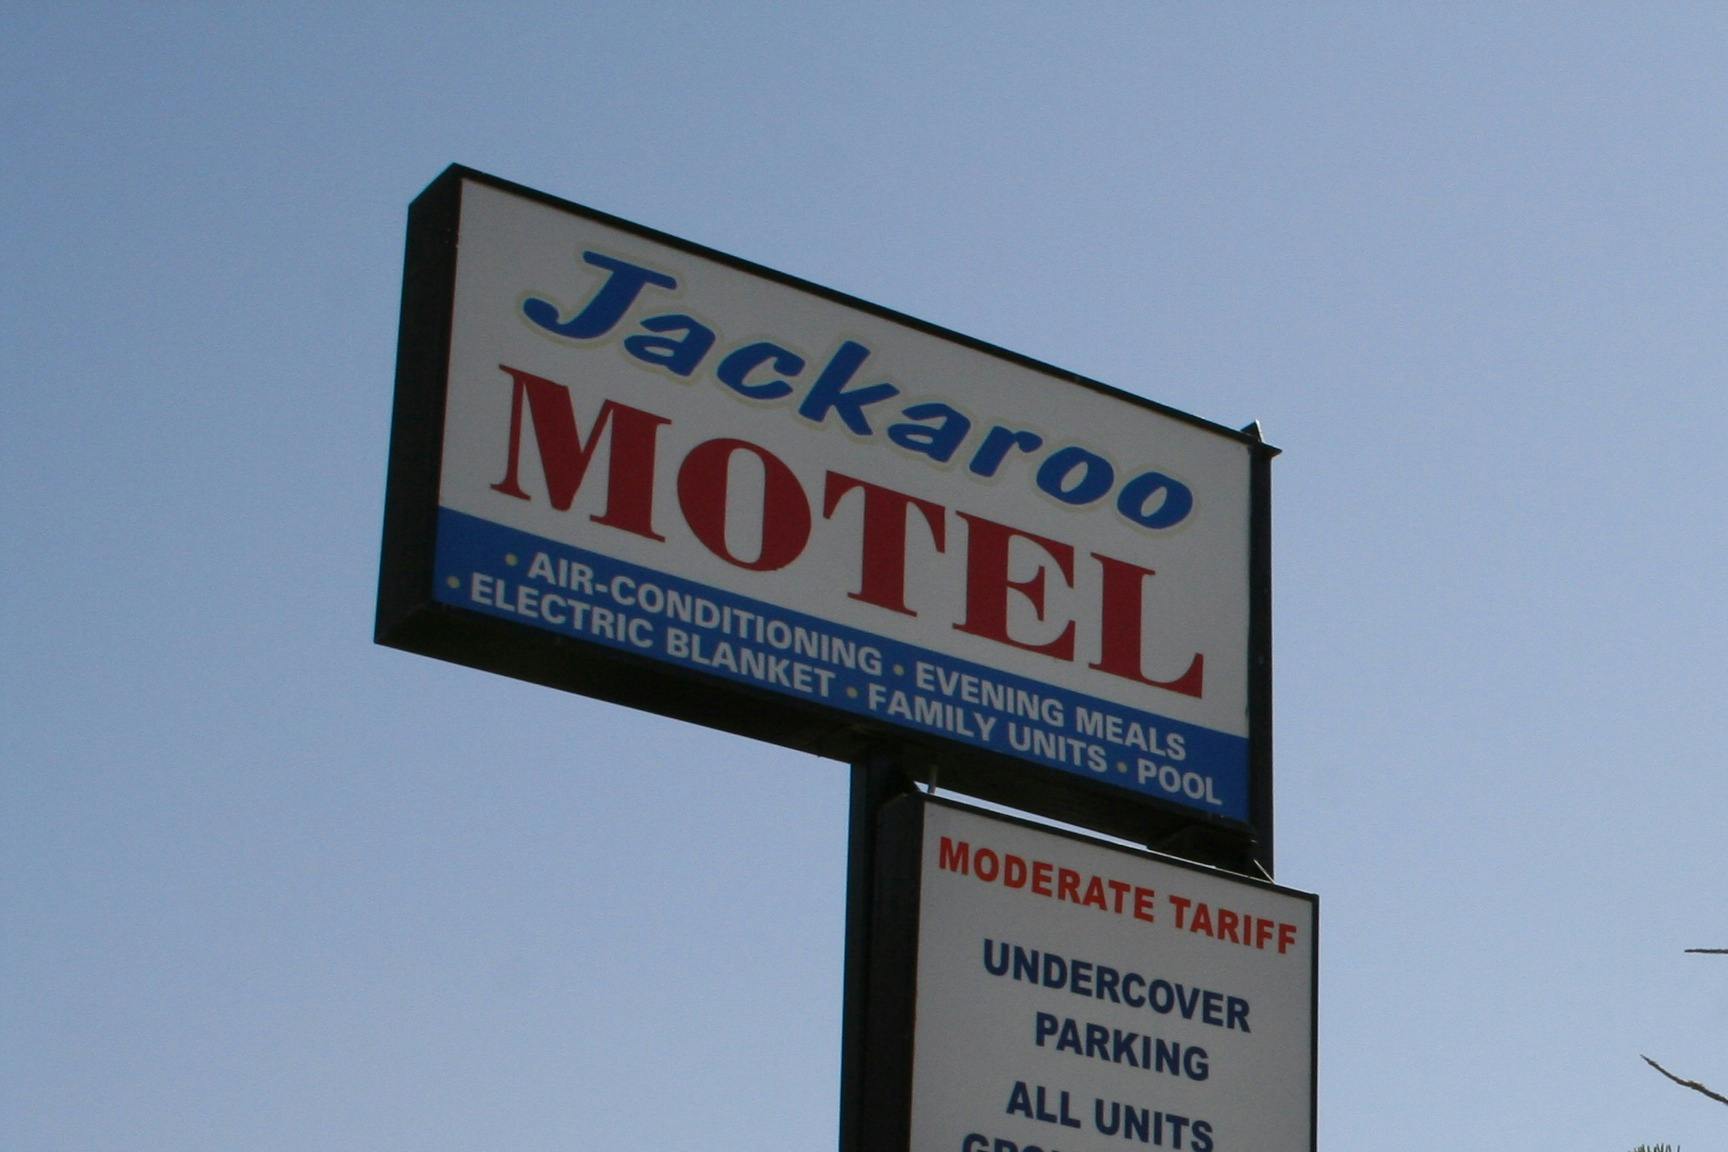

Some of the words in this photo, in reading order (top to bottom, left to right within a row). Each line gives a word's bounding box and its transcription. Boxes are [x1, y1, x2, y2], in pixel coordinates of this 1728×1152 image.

[522, 250, 1194, 529] Jackaroo
[490, 364, 1204, 700] MOTEL
[472, 575, 654, 650] ELECTRIC
[667, 628, 836, 698] BLANKET
[868, 685, 1018, 745] FAMILY
[1009, 722, 1107, 773] UNITS
[1138, 758, 1222, 806] POOL
[529, 552, 882, 676] AIR-CONDITIONING
[917, 662, 1064, 728] EVENING
[1077, 708, 1187, 761] MEALS
[939, 836, 1155, 922] MODERATE
[1169, 895, 1297, 954] TARIFF
[984, 938, 1250, 1033] UNDERCOVER
[1035, 1012, 1209, 1081] PARKING
[1006, 1081, 1081, 1129] ALL
